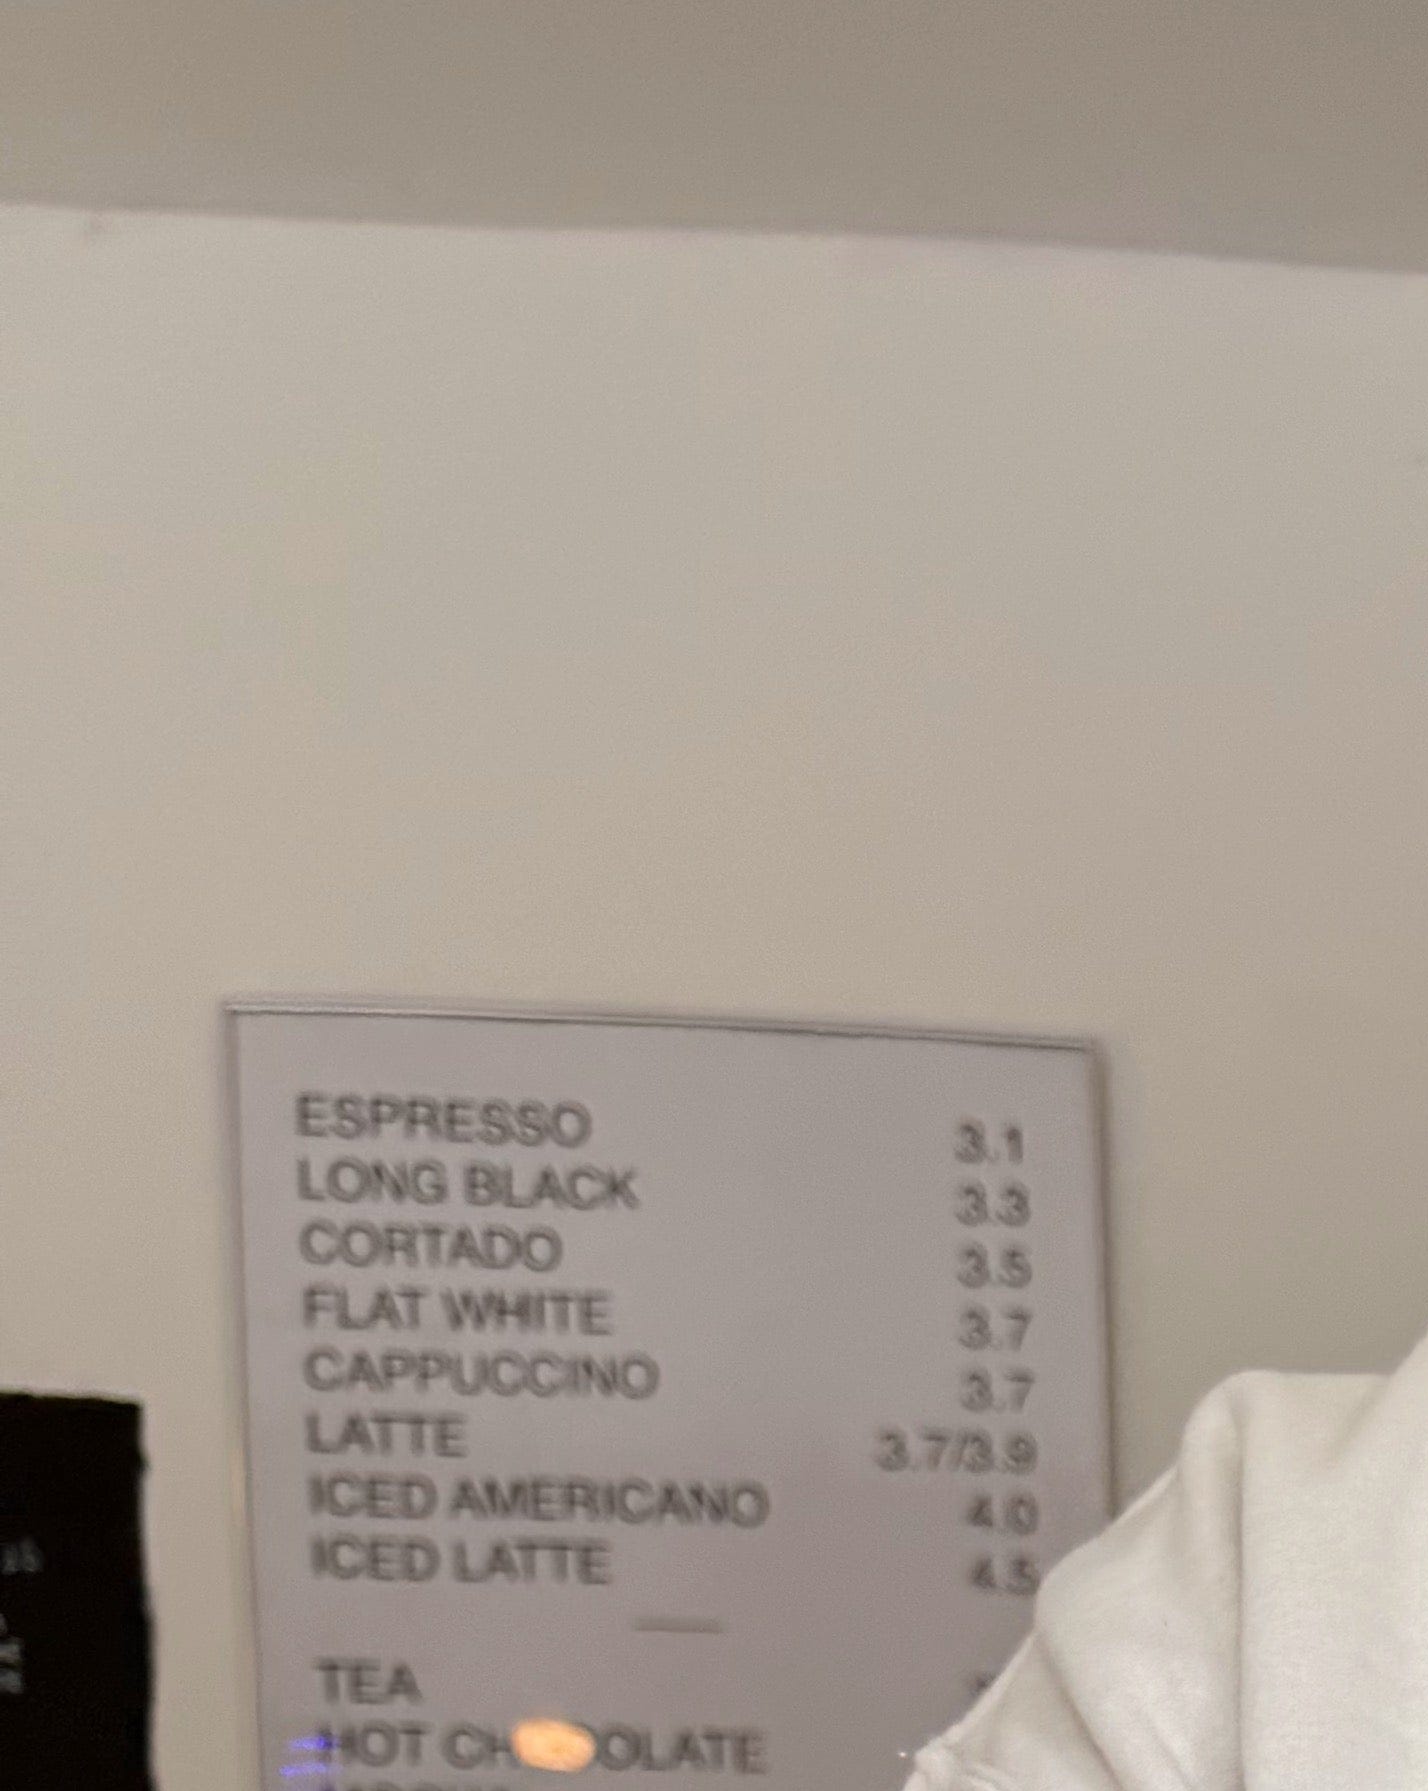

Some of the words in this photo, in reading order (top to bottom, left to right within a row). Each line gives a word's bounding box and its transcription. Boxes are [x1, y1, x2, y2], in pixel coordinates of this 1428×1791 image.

[295, 1091, 593, 1148] ESPRESSO
[954, 1119, 1026, 1165] 3.1
[297, 1157, 447, 1205] LONG
[465, 1160, 642, 1209] BLACK
[954, 1183, 1031, 1228] 3.3
[299, 1220, 564, 1273] CORTADO
[957, 1243, 1033, 1290] 3.5
[302, 1285, 422, 1332] FLAT
[443, 1288, 613, 1338] WHITE
[959, 1306, 1034, 1353] 3.7
[302, 1346, 662, 1401] CAPPUCCINO
[962, 1368, 1038, 1414] 3.7
[305, 1410, 468, 1459] LATTE
[877, 1425, 1039, 1475] 3.7/3.9
[308, 1474, 438, 1521] ICED
[449, 1478, 772, 1530] AMERICANO
[310, 1536, 439, 1584] ICED
[452, 1539, 612, 1588] LATTE
[313, 1657, 423, 1705] TEA
[317, 1719, 431, 1768] HOT
[443, 1722, 768, 1775] CHOLATE
